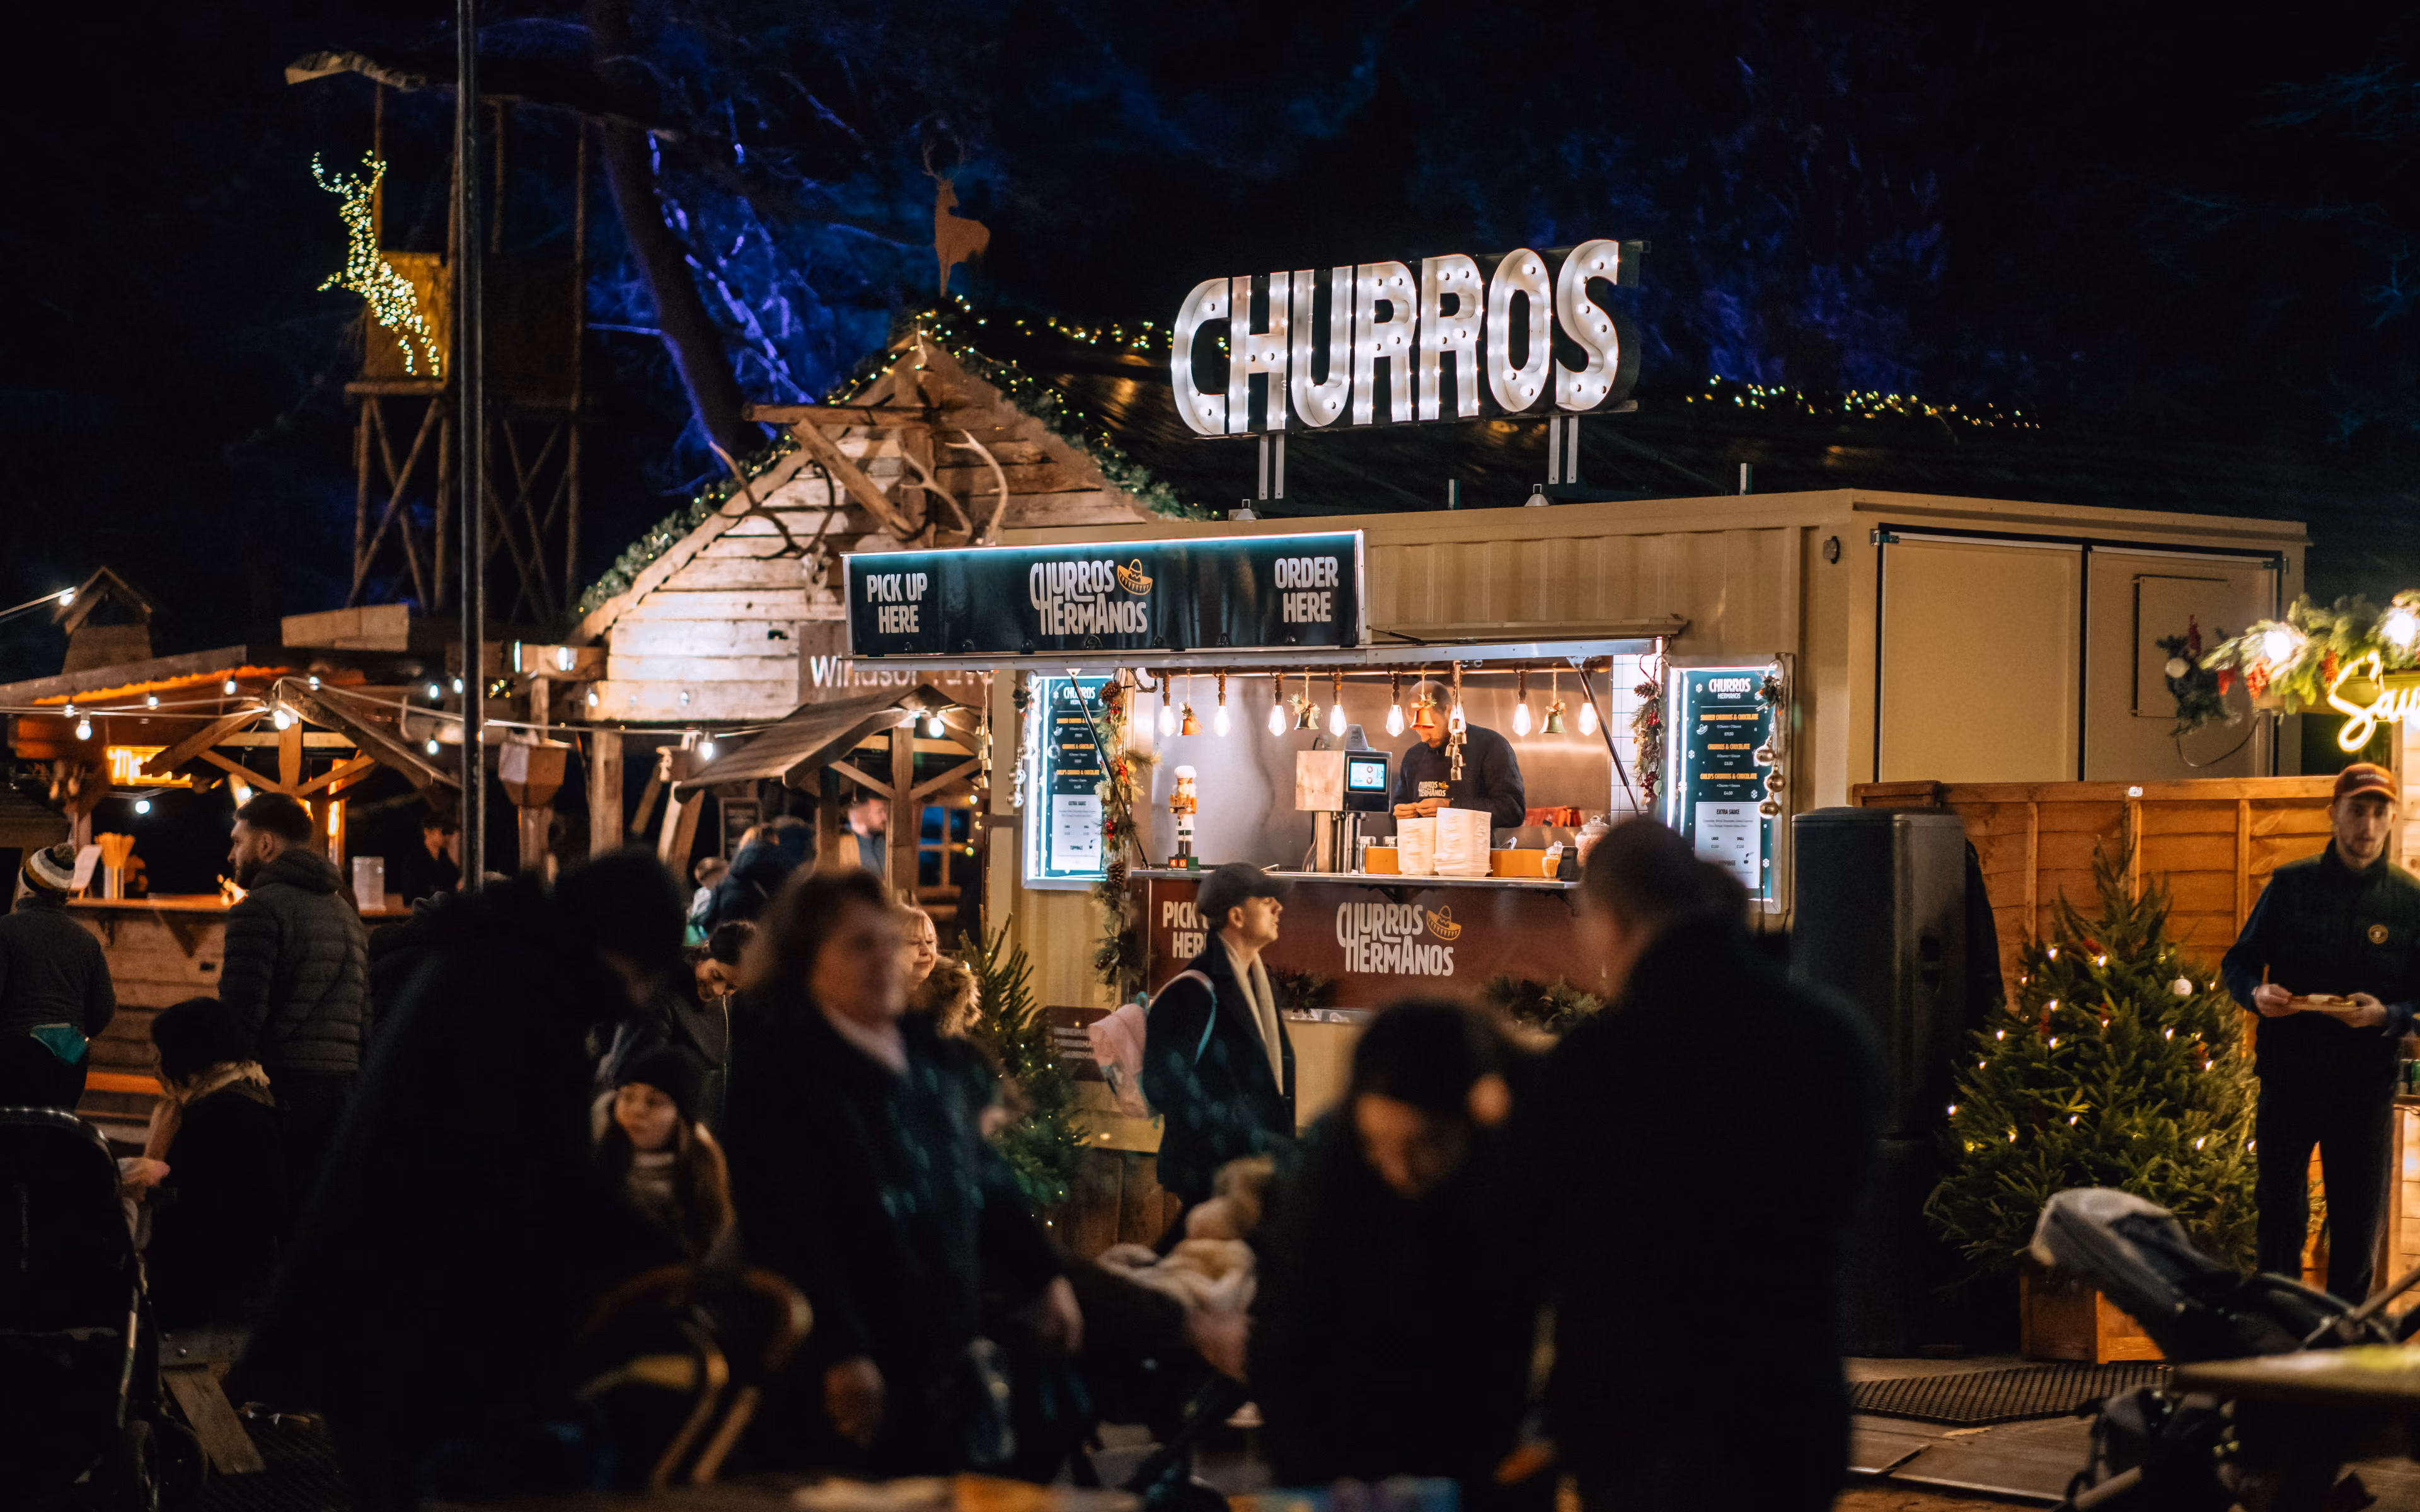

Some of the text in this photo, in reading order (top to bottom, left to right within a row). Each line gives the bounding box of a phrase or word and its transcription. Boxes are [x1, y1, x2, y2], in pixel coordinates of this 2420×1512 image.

[1171, 239, 1619, 435] CHURROS
[867, 573, 928, 602] PICK UP
[1030, 559, 1115, 610] CHURROS
[1275, 556, 1339, 588] ORDER
[879, 605, 919, 634] HERE
[1040, 592, 1148, 636] HERMANOS
[1283, 592, 1331, 622] HERE
[1708, 678, 1751, 692] CHURROS
[1163, 901, 1197, 929] PICK
[1336, 902, 1424, 948] CHURROS
[1172, 931, 1207, 958] HER
[1345, 935, 1454, 976] HERMANOS
